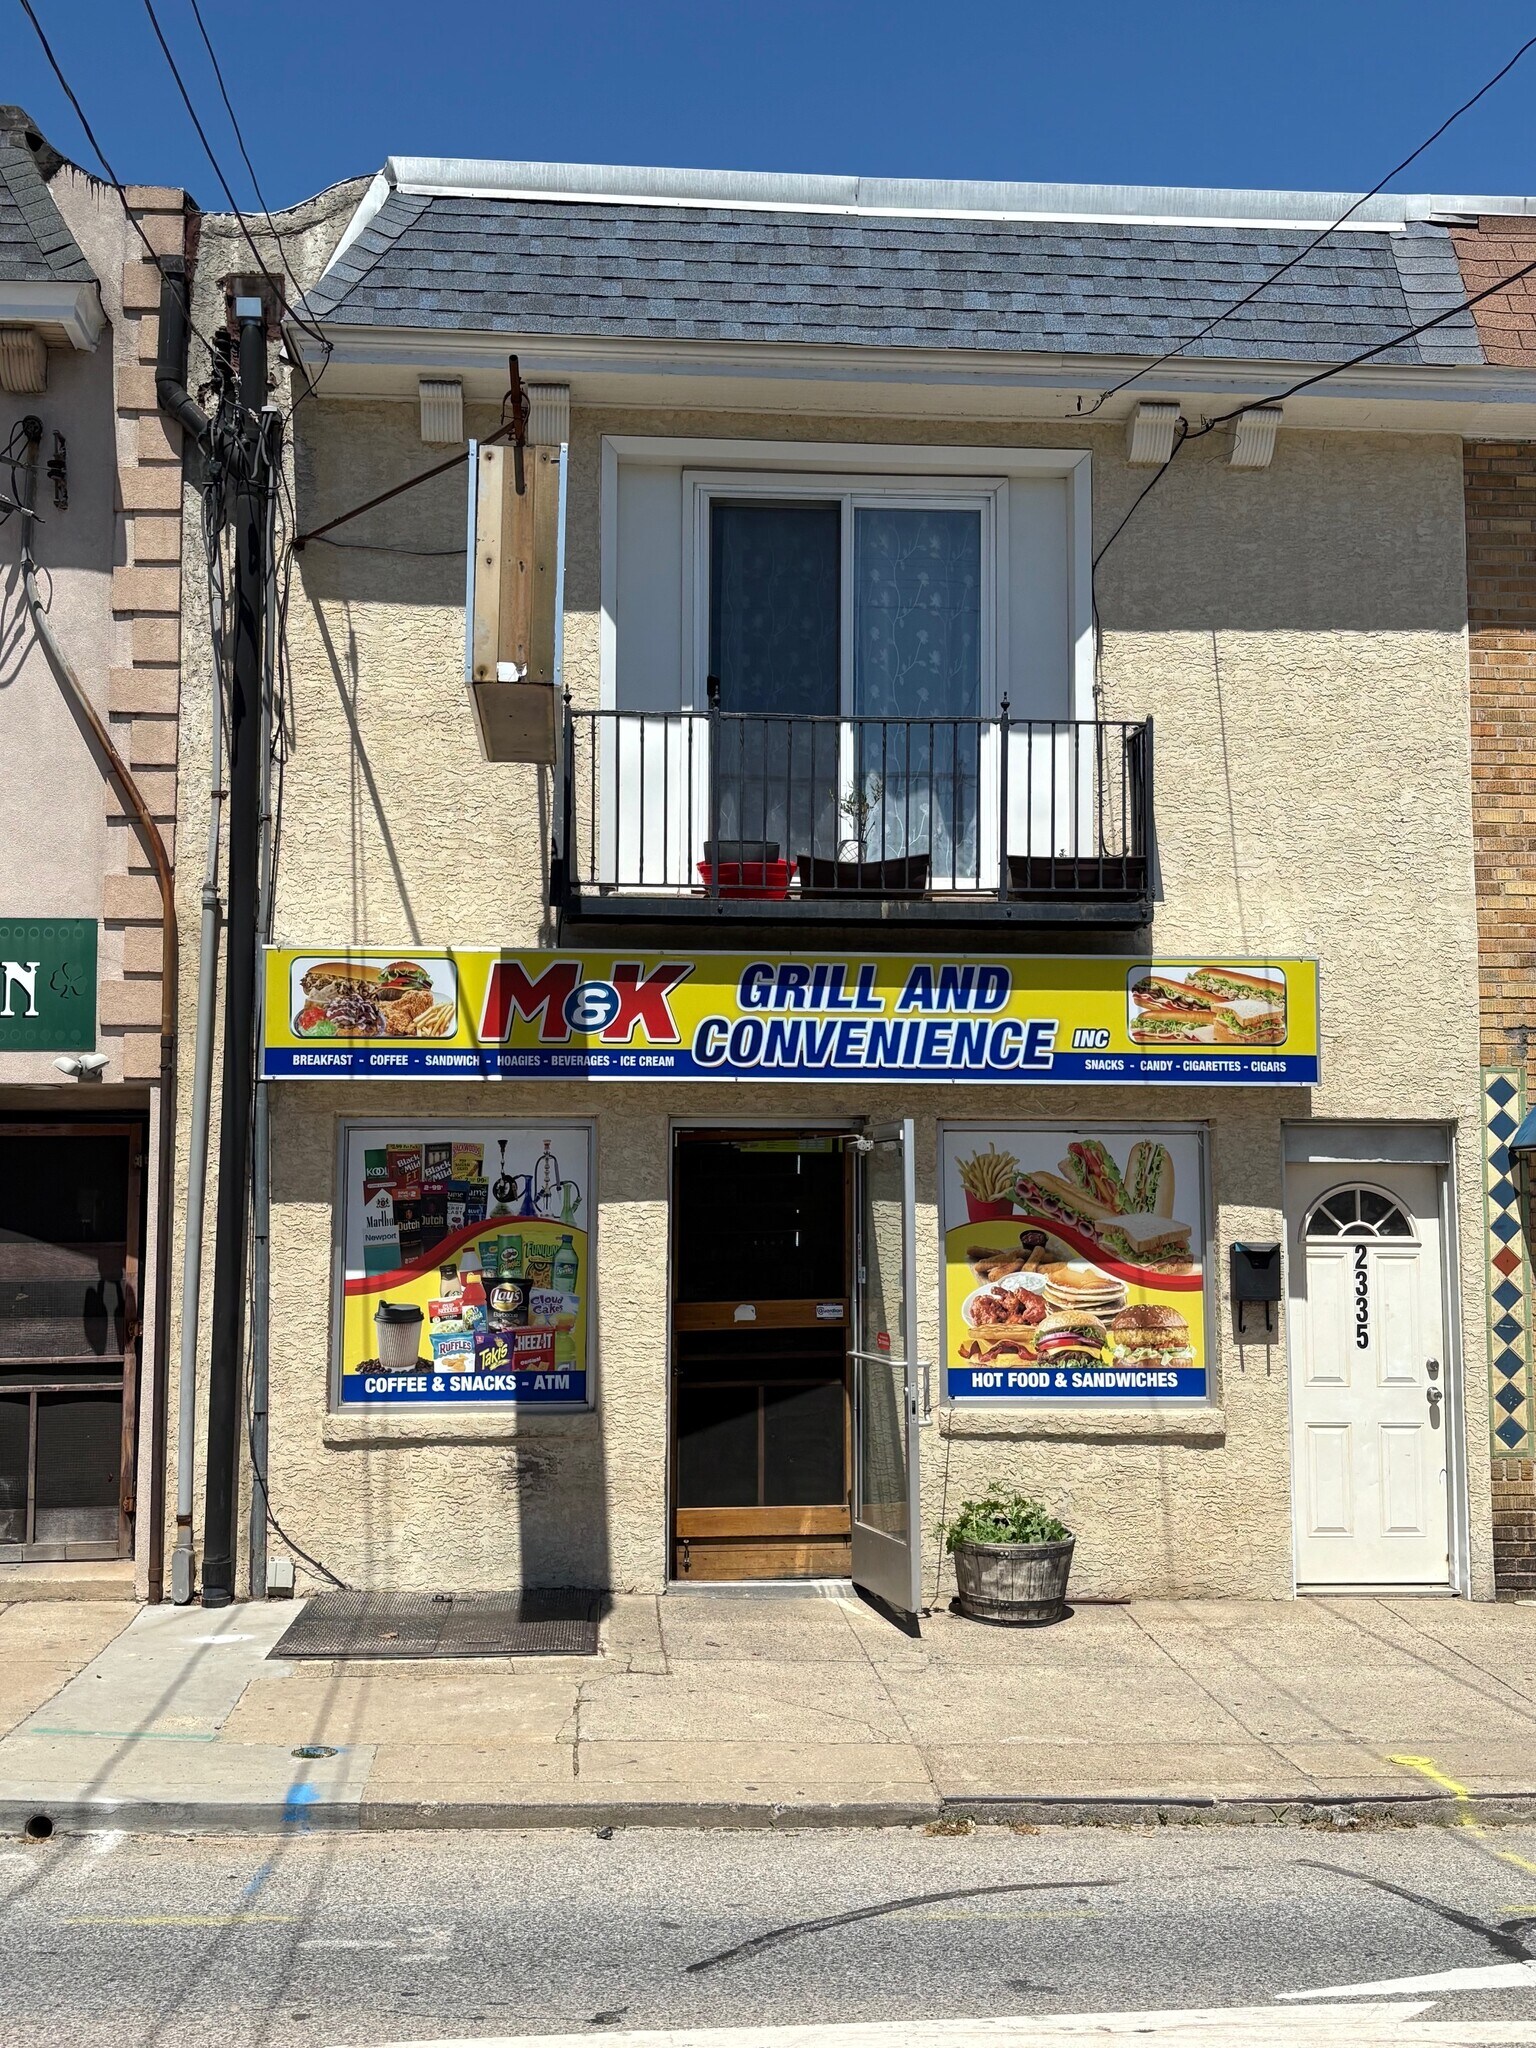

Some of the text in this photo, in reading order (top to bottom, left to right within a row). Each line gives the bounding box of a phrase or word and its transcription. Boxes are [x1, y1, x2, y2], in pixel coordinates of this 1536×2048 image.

[737, 962, 1013, 1014] GRILL AND
[478, 959, 695, 1043] M&K
[691, 1015, 1059, 1069] CONVENIENCE
[1072, 1028, 1110, 1049] INC
[292, 1054, 353, 1066] BREAKFAST
[369, 1054, 409, 1066] COFFEE
[425, 1054, 480, 1067] SANDWICH
[497, 1055, 541, 1067] HOAGIES
[551, 1055, 610, 1067] BEVERAGES
[620, 1056, 637, 1067] ICE
[638, 1056, 675, 1067] CREAM
[1085, 1059, 1125, 1071] SNACKS
[1140, 1060, 1173, 1072] CANDY
[1182, 1060, 1241, 1072] CIGARETTES
[1250, 1061, 1287, 1073] CIGARS
[396, 1153, 420, 1168] Black
[404, 1160, 421, 1174] Mild
[424, 1160, 451, 1177] Black
[432, 1168, 453, 1182] Mild
[365, 1233, 397, 1242] Newport
[531, 1295, 564, 1306] Cloud
[1354, 1244, 1370, 1349] 2335
[532, 1304, 563, 1315] Cakes
[439, 1341, 472, 1354] RUFFLES
[479, 1343, 509, 1370] Takis
[364, 1376, 428, 1394] COFFEE
[431, 1376, 445, 1392] &
[449, 1374, 517, 1392] SNACKS
[533, 1374, 570, 1390] ATM
[971, 1372, 1178, 1388] HOT FOOD & SANDWICHES
